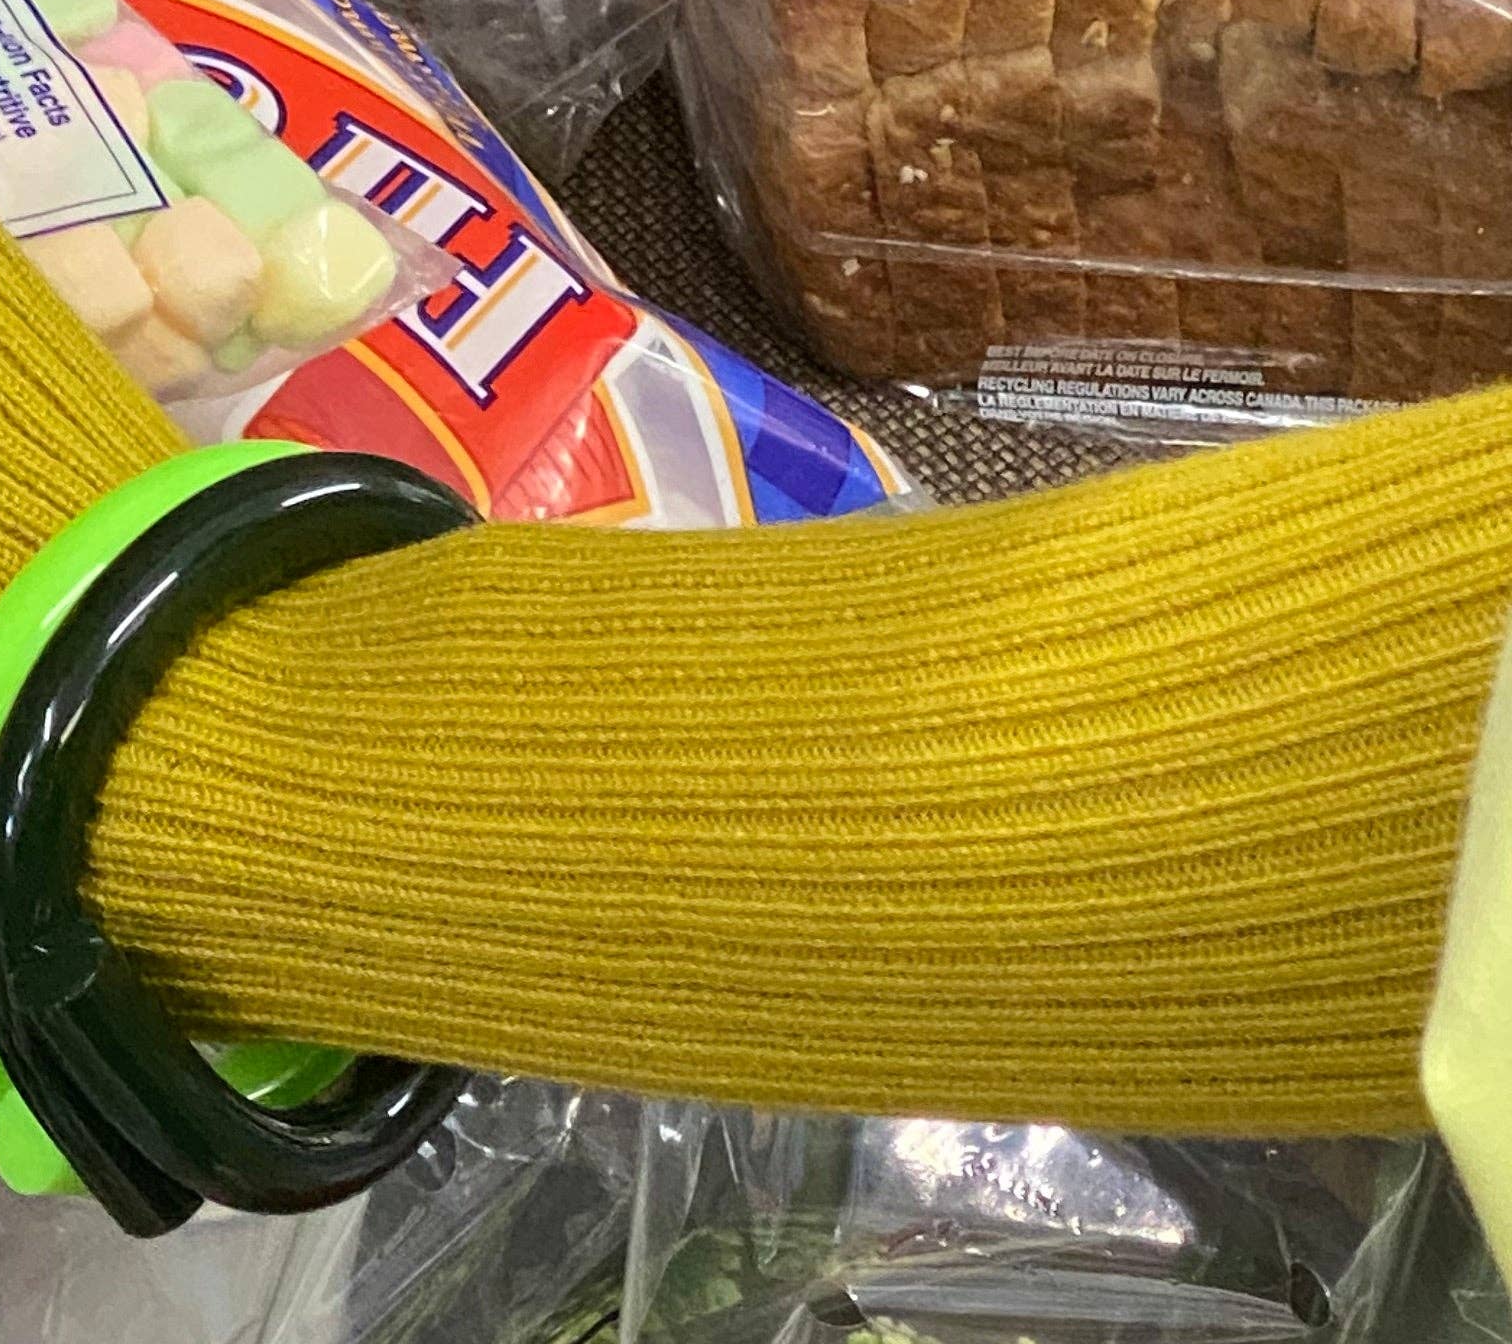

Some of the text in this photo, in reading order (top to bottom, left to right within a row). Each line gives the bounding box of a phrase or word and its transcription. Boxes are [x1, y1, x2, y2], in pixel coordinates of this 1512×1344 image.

[23, 64, 73, 129] Facts
[1051, 362, 1092, 376] AVANT
[1094, 363, 1111, 377] LA
[1114, 365, 1148, 379] DATE
[1151, 367, 1180, 381] SUR
[1183, 368, 1201, 382] LE
[977, 376, 1055, 395] RECYCLING
[1057, 380, 1148, 400] REGULATIONS
[1151, 386, 1187, 402] VARY
[1190, 389, 1244, 406] ACROSS
[1305, 395, 1335, 411] THIS
[977, 393, 997, 407] LA
